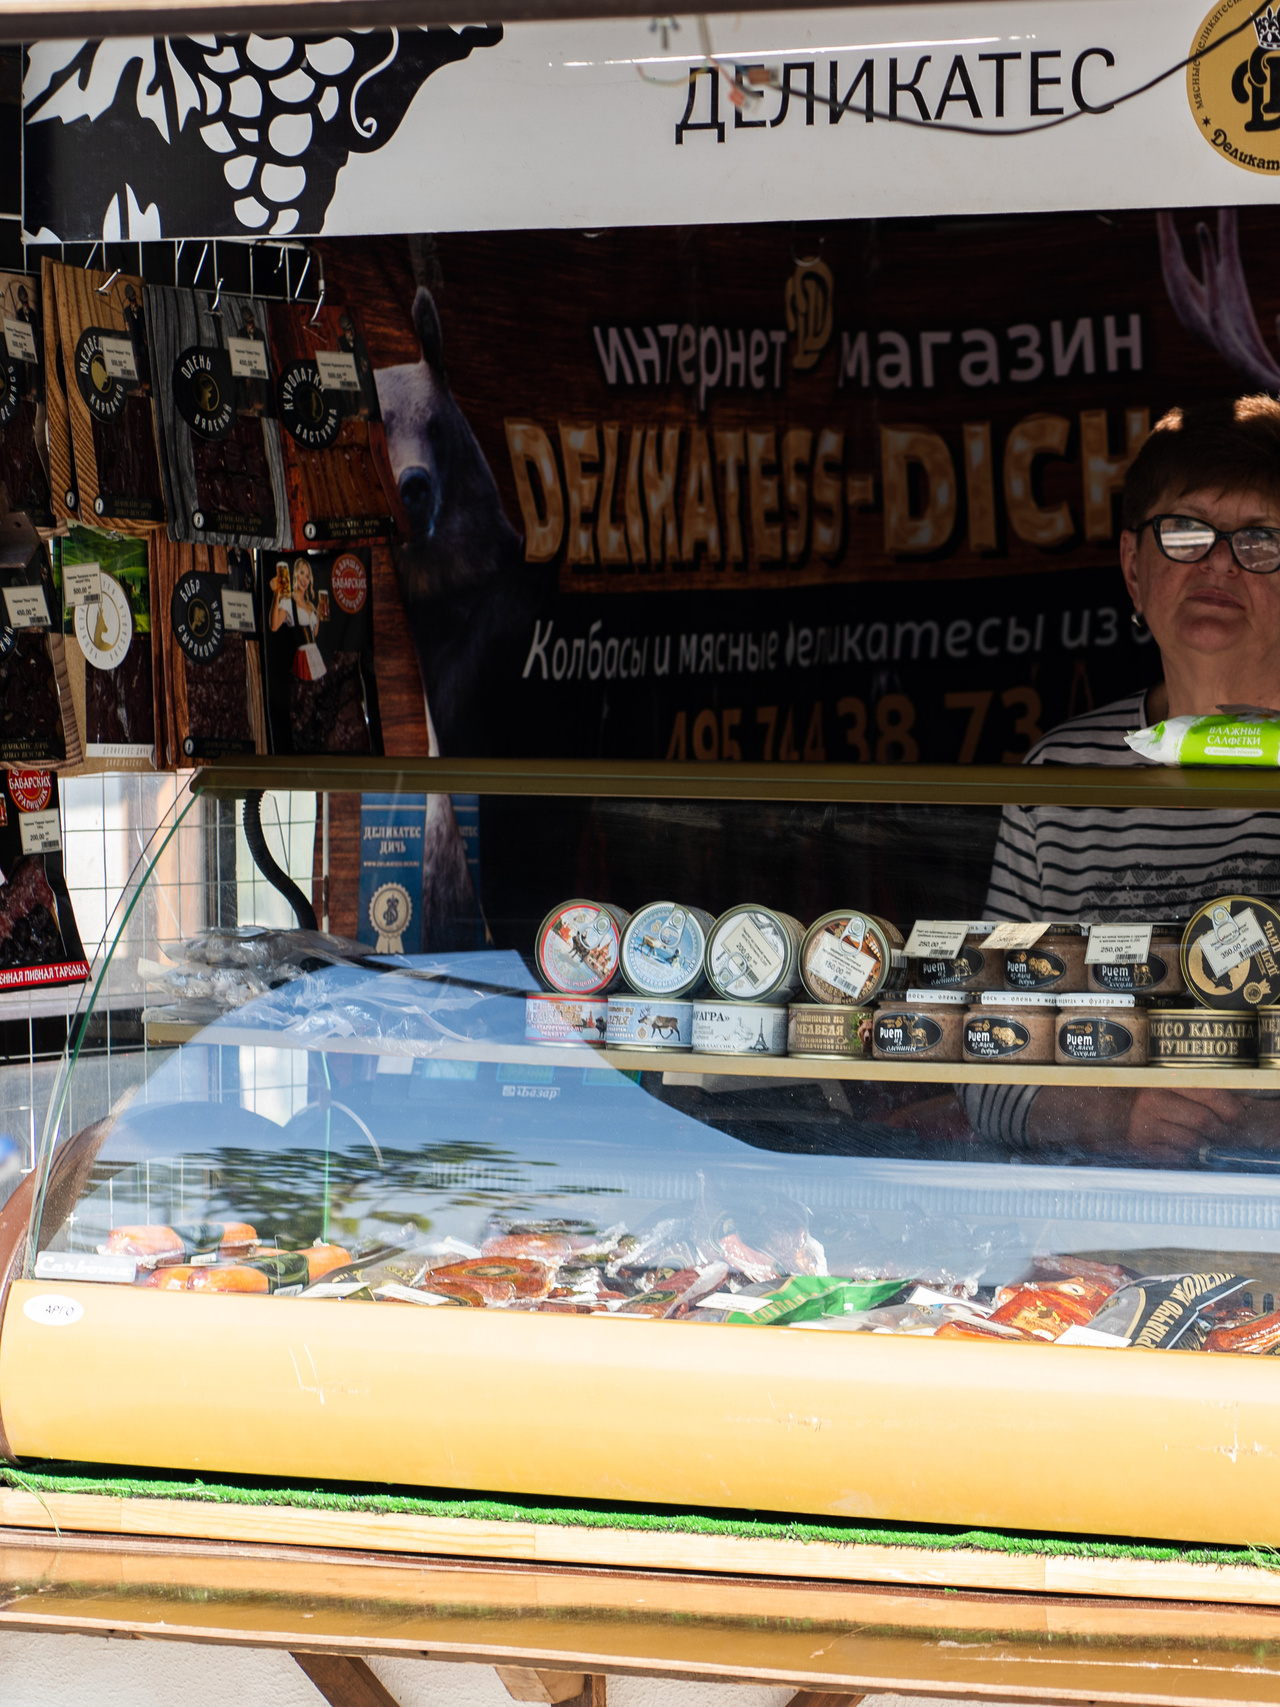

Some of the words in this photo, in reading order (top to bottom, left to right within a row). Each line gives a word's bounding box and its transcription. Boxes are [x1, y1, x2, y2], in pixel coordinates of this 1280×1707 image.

[675, 47, 1115, 145] ДЕЛИКАТЕС
[181, 354, 212, 380] ОЛЕНЬ
[592, 322, 787, 412] интернет
[838, 313, 1144, 390] магазин
[295, 408, 338, 443] БАСТУРМА
[180, 579, 200, 603] БОБР
[522, 619, 649, 681] Колбасы
[653, 638, 670, 676] и
[678, 630, 778, 676] мясные
[1060, 606, 1120, 650] из
[1209, 726, 1262, 736] ВЛАЖНЫЕ
[1207, 735, 1261, 746] САЛФЕТКИ
[9, 776, 51, 790] БАВАРСКИХ
[15, 788, 48, 811] ТРАДИЦИЯХ
[363, 825, 422, 841] ДЕЛИКАТЕС
[379, 840, 406, 856] ДИЧЬ
[918, 940, 939, 948] 250,00
[1220, 943, 1242, 959] 350,00
[25, 966, 54, 982] ПИВНАЯ
[54, 963, 88, 979] ТАРЕЛКА
[825, 960, 844, 975] 150,00
[923, 961, 946, 974] Риет
[1007, 961, 1027, 973] Риет
[1102, 965, 1128, 977] Риет
[1089, 997, 1115, 1005] фуагра
[796, 1012, 831, 1024] Паштет
[833, 1015, 845, 1024] из
[796, 1024, 844, 1036] МЕДВЕДЯ
[879, 1027, 903, 1039] Риет
[968, 1030, 990, 1042] Риет
[1150, 1021, 1185, 1037] МЯСО
[1188, 1021, 1254, 1038] КАБАНА
[1066, 1033, 1093, 1046] Риет
[1158, 1039, 1240, 1055] ТУШЕНОЕ
[38, 1255, 132, 1277] Carboma
